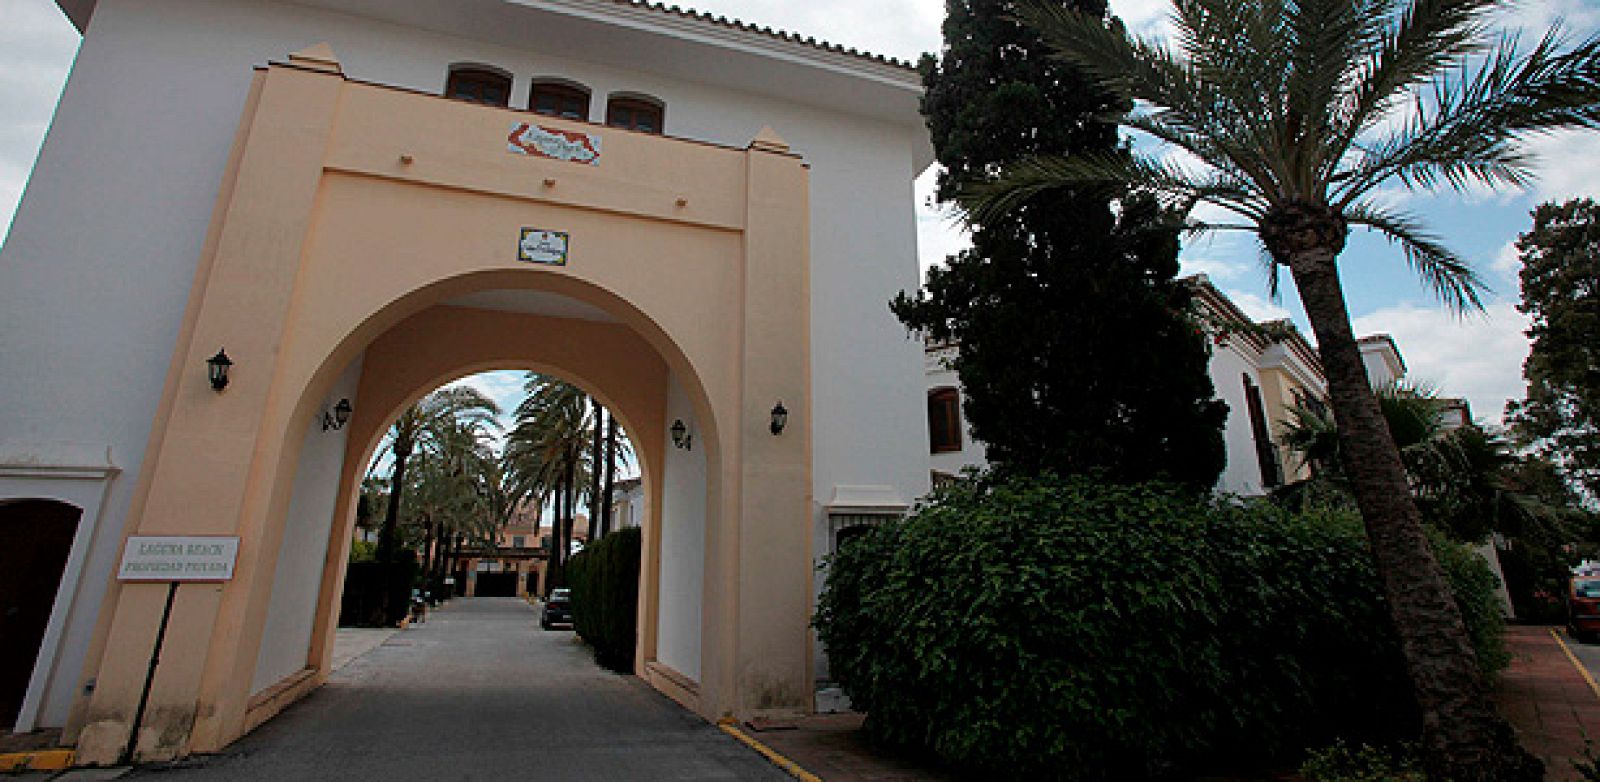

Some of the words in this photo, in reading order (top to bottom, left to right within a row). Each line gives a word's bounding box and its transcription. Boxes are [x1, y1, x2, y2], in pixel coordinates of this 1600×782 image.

[139, 543, 183, 556] LAGUNA
[187, 544, 225, 556] BEACH
[124, 562, 183, 572] PROPIEDAD
[184, 562, 228, 572] PRIVADA
